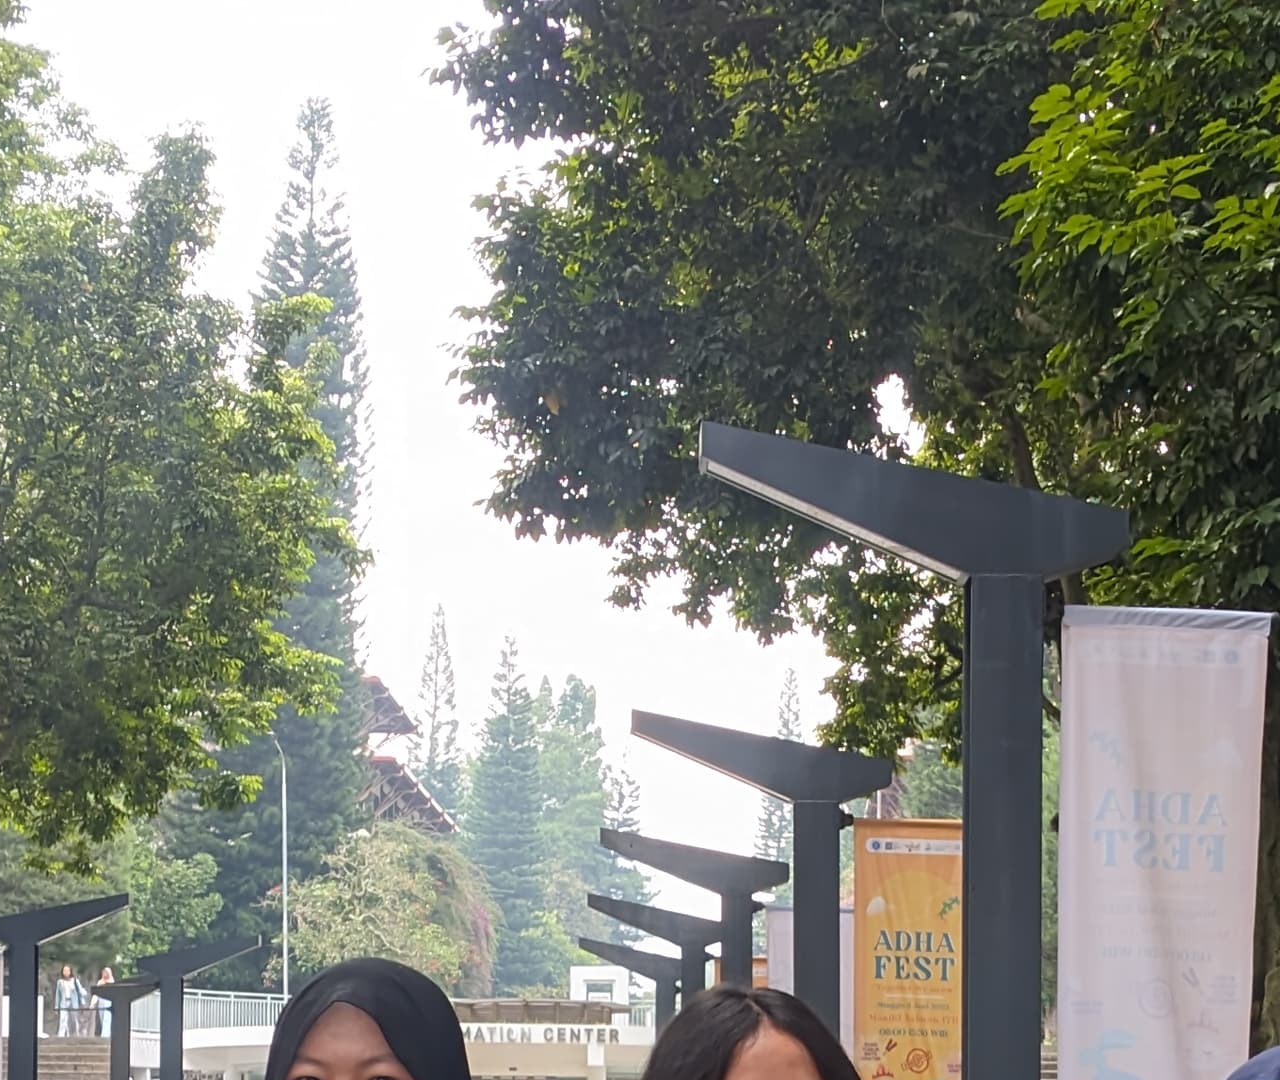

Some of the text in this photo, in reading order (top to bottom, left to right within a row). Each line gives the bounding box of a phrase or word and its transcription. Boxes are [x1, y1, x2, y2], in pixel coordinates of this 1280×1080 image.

[873, 930, 955, 953] ADHA
[874, 955, 956, 981] FEST
[463, 1026, 620, 1043] MATION CENTER
